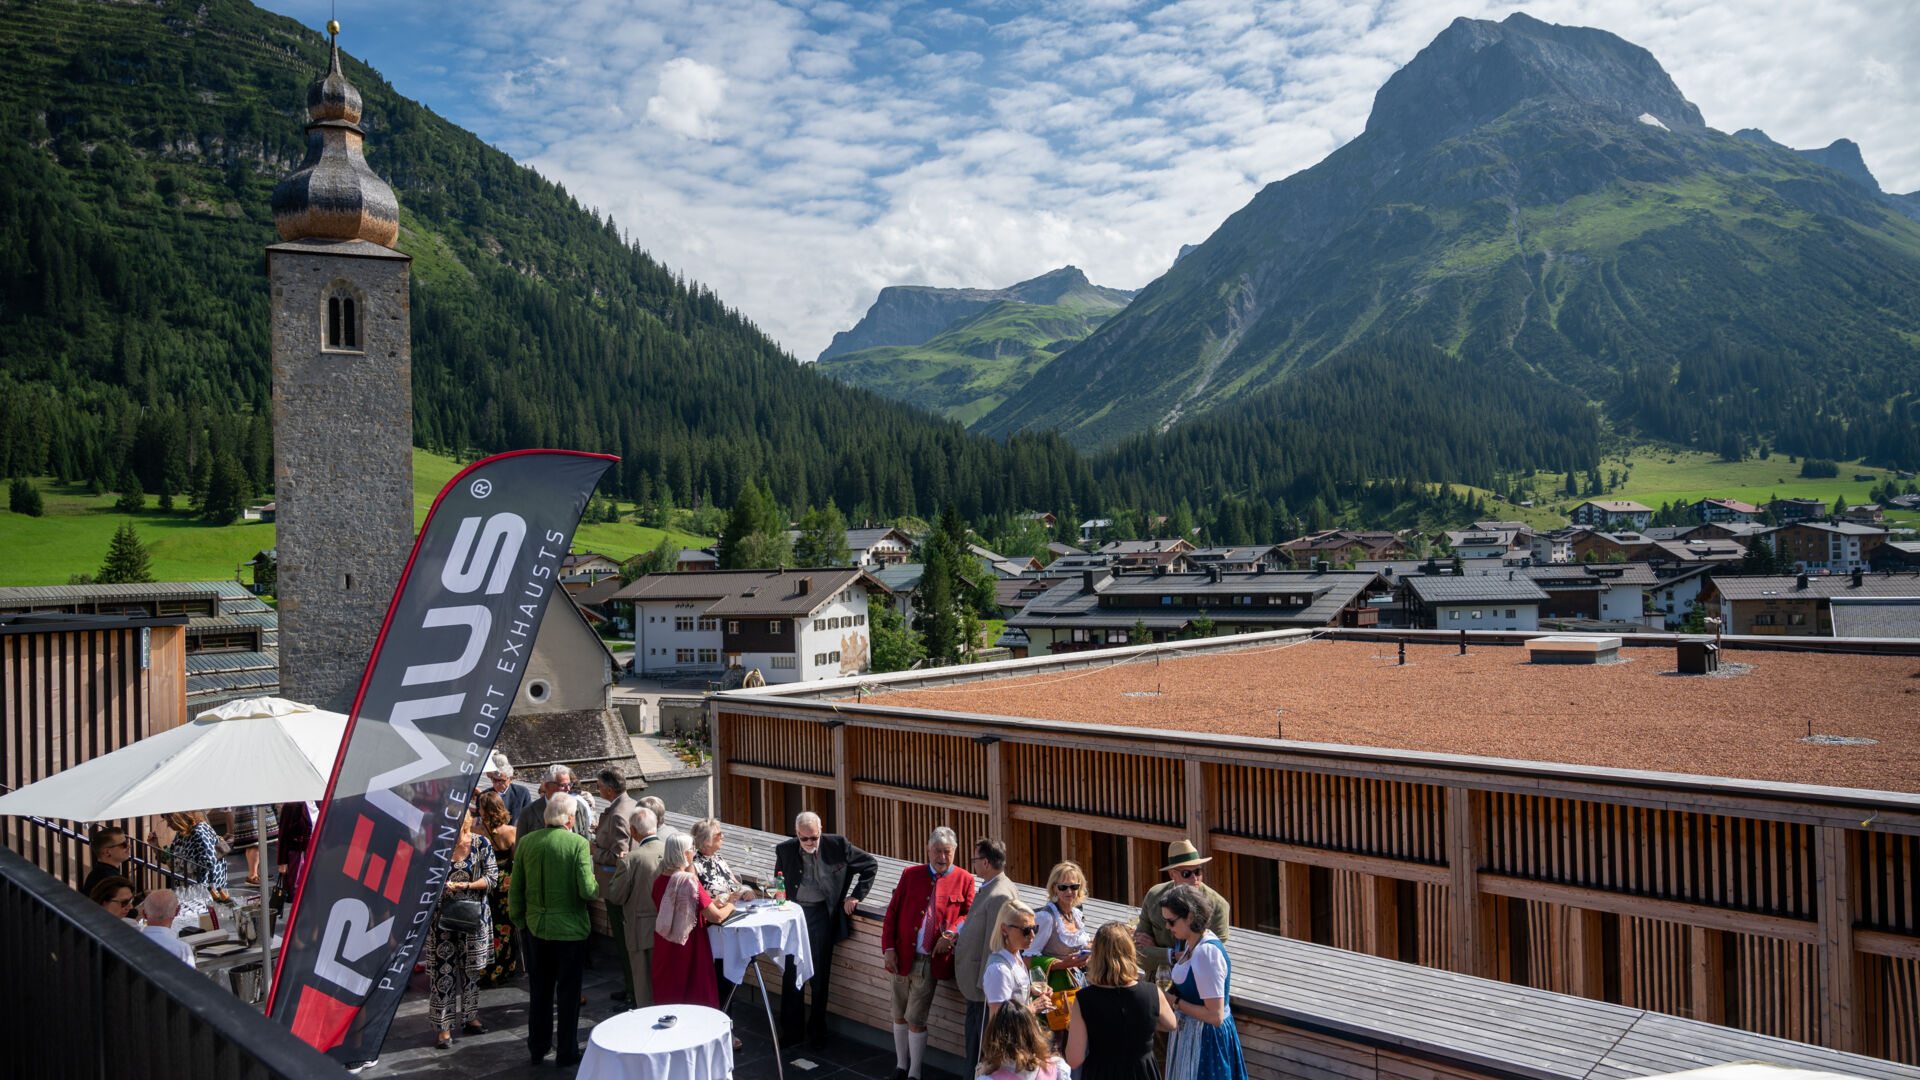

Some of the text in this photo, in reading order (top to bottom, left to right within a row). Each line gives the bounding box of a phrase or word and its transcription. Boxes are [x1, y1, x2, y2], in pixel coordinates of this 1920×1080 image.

[378, 529, 564, 991] PERFORMANCE SPORT EXHAUSTS
